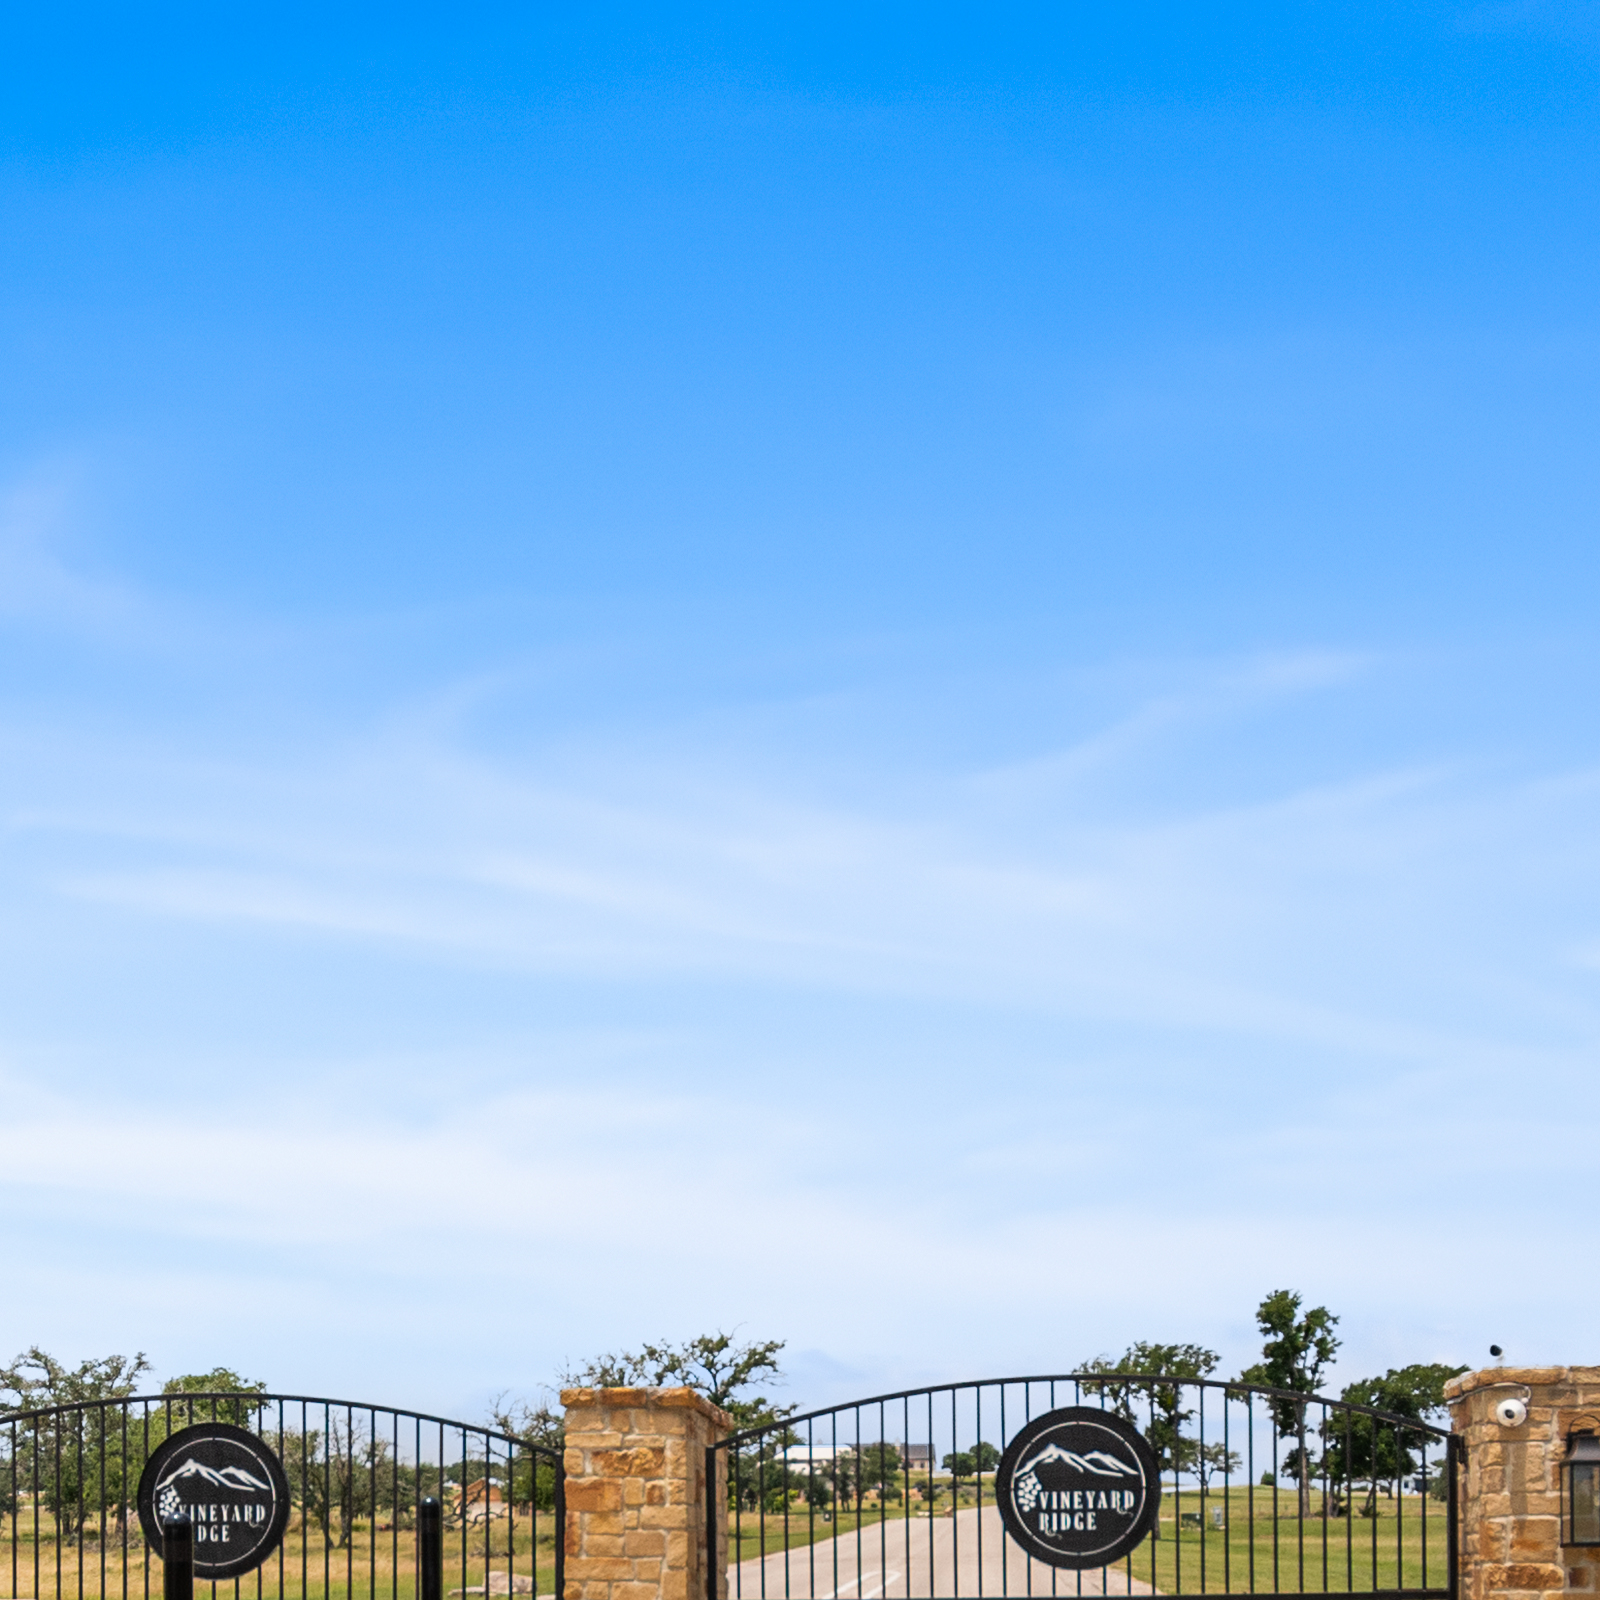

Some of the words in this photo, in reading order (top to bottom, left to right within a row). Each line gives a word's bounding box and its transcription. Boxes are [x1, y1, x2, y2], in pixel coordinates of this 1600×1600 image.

[1039, 1491, 1135, 1517] VINEYARD
[198, 1525, 230, 1542] DGE
[1039, 1513, 1097, 1540] RIDGE
